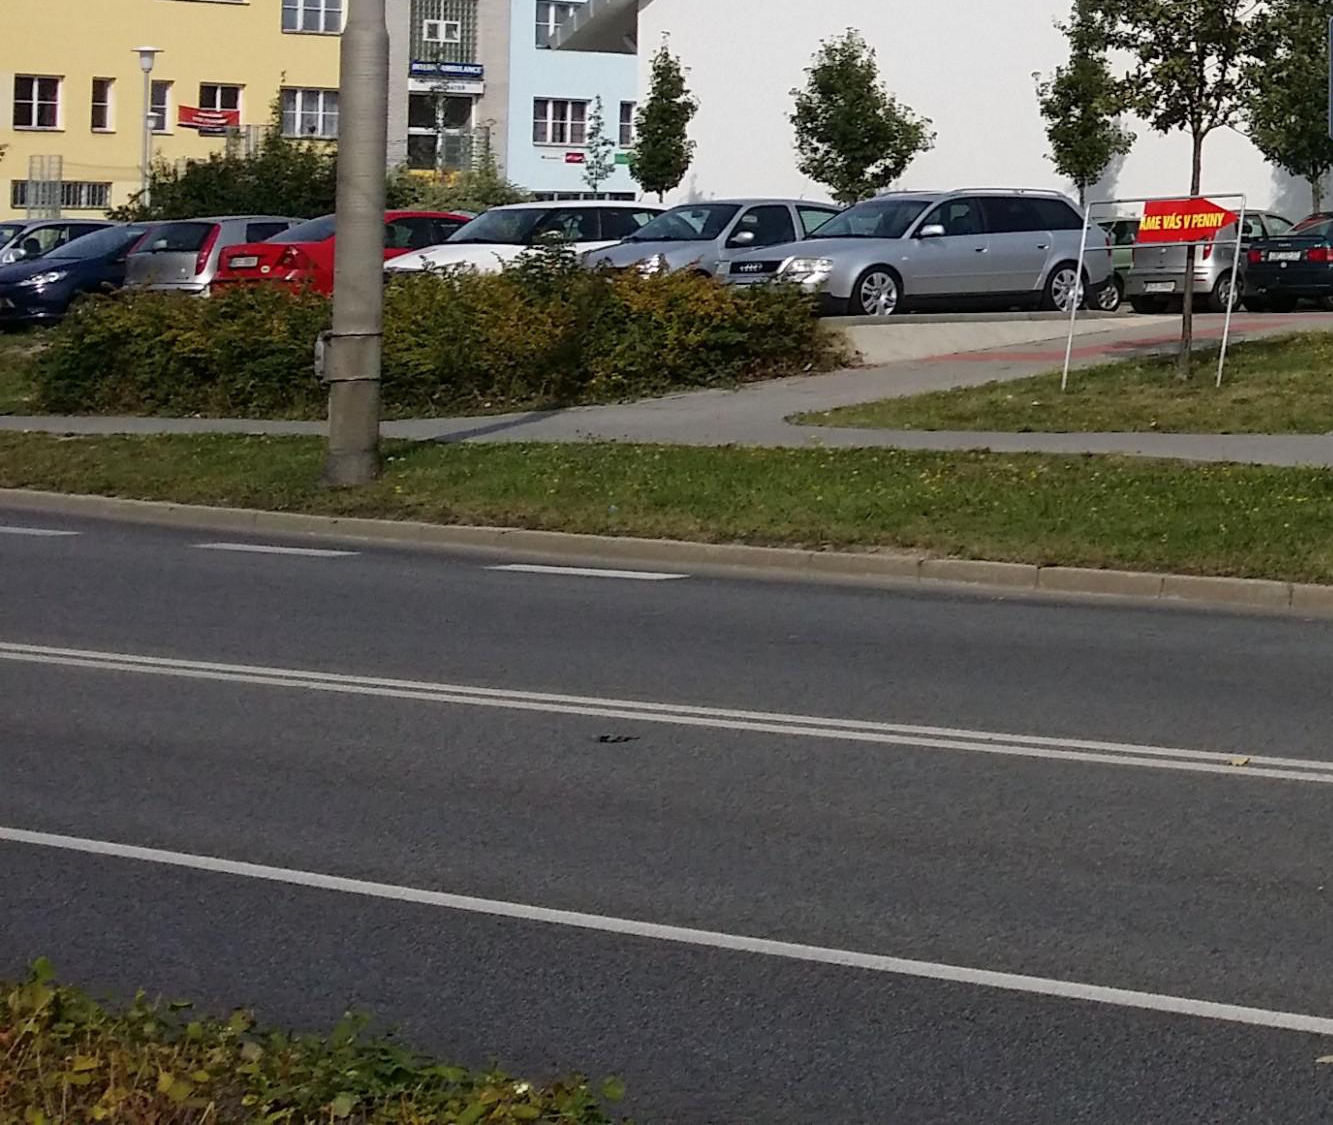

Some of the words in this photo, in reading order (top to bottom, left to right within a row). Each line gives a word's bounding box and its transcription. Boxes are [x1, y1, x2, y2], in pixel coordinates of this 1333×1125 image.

[1163, 213, 1182, 229] VÁS
[1184, 214, 1191, 229] V
[1191, 213, 1225, 228] PENNY
